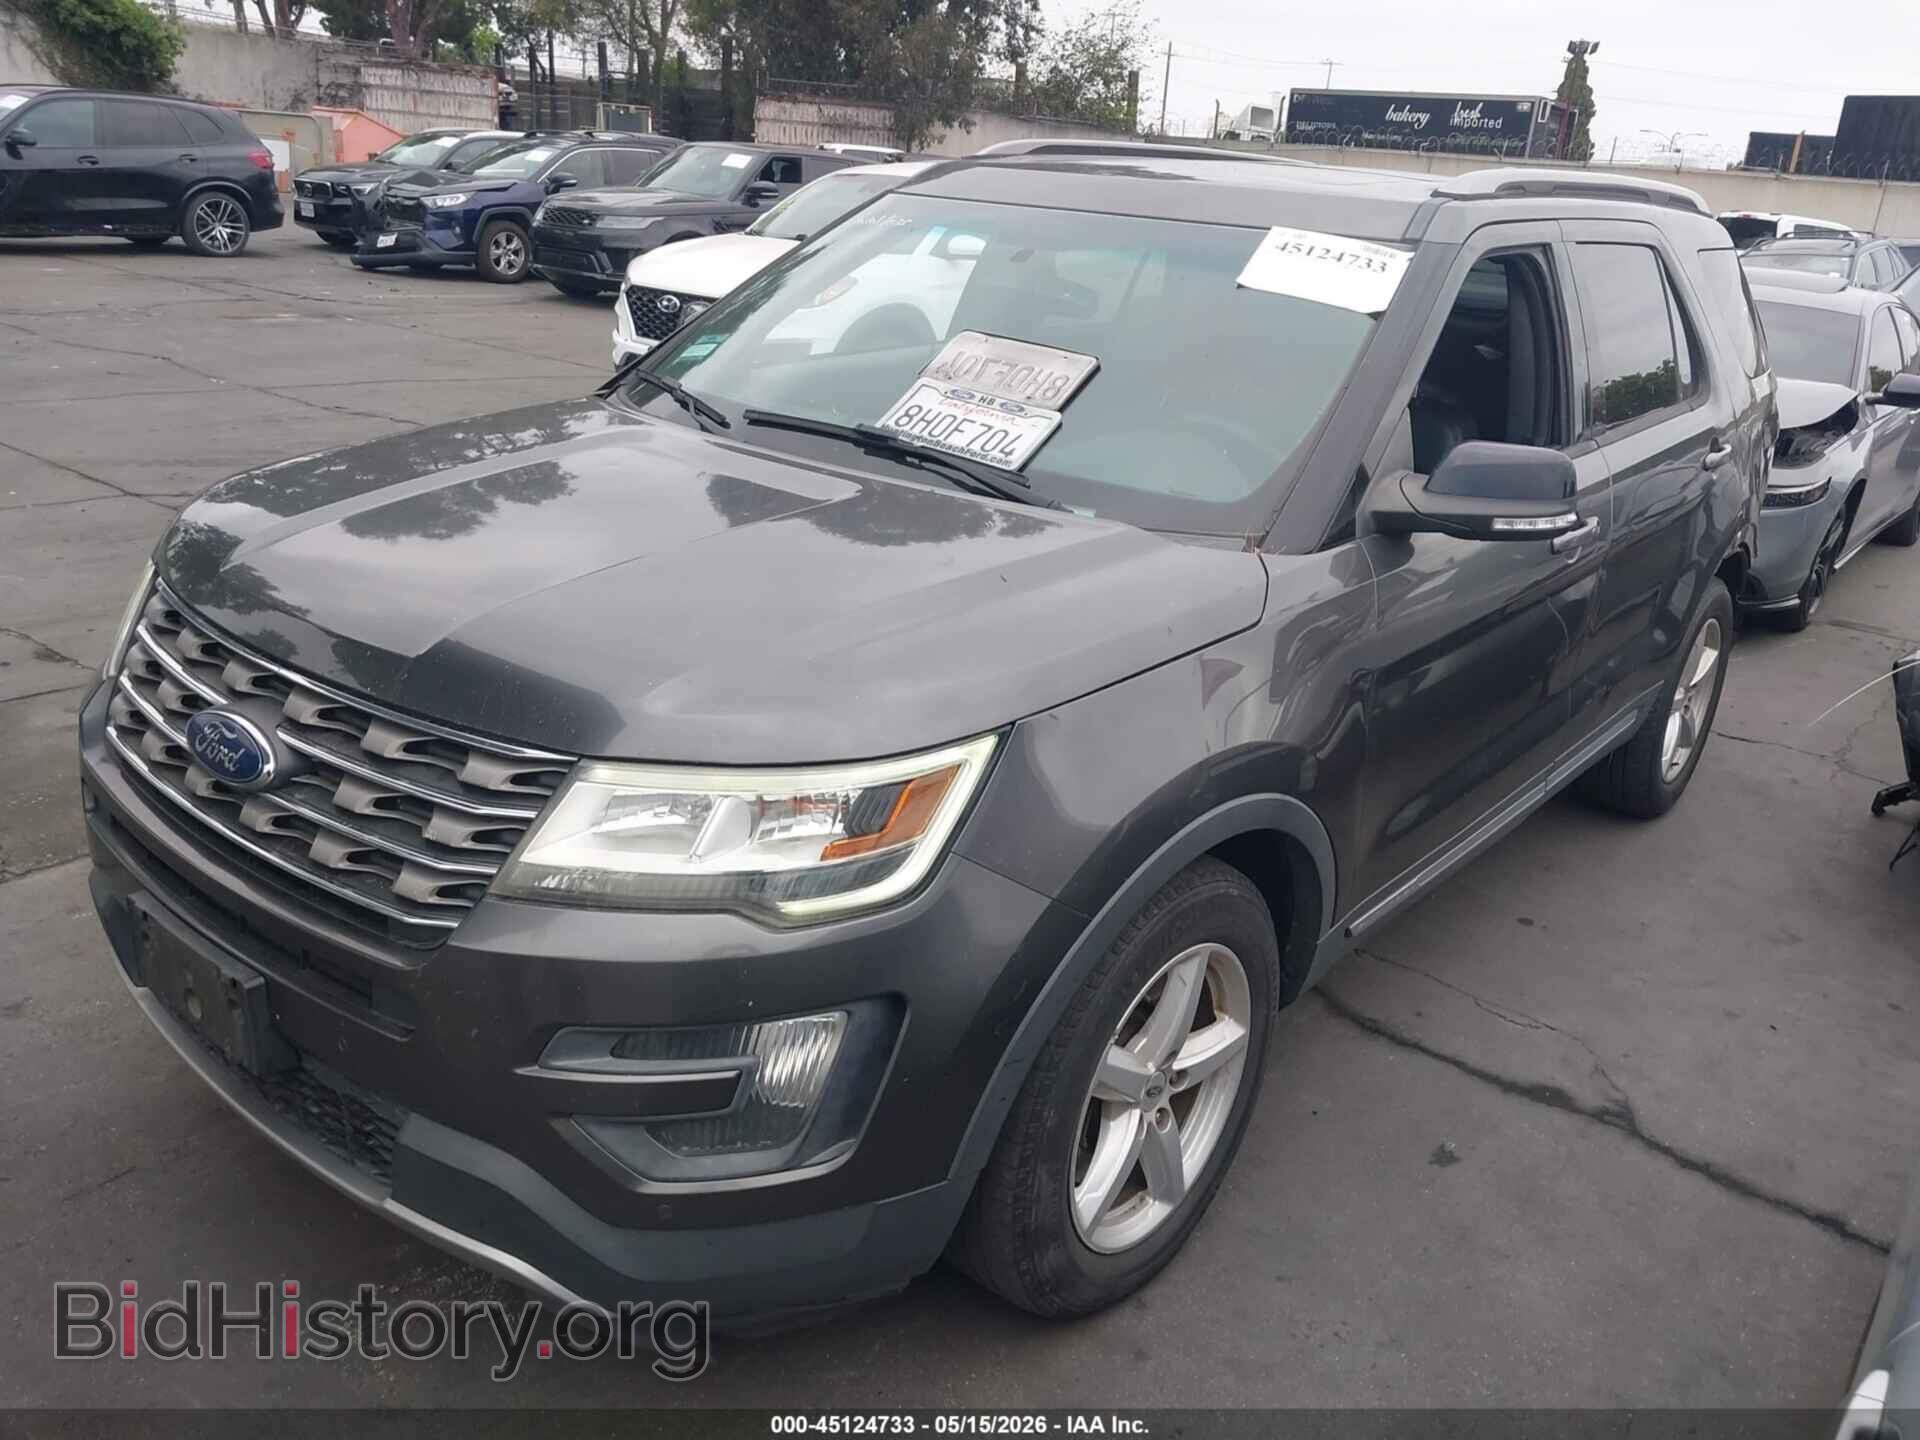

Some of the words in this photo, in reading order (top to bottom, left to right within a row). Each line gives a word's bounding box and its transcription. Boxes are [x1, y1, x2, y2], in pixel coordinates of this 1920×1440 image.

[1385, 104, 1430, 129] bakery
[1450, 115, 1503, 129] imported
[1275, 241, 1388, 273] 45124733
[978, 396, 996, 405] HB
[894, 404, 1023, 458] 8HOF704
[195, 720, 246, 772] Ford
